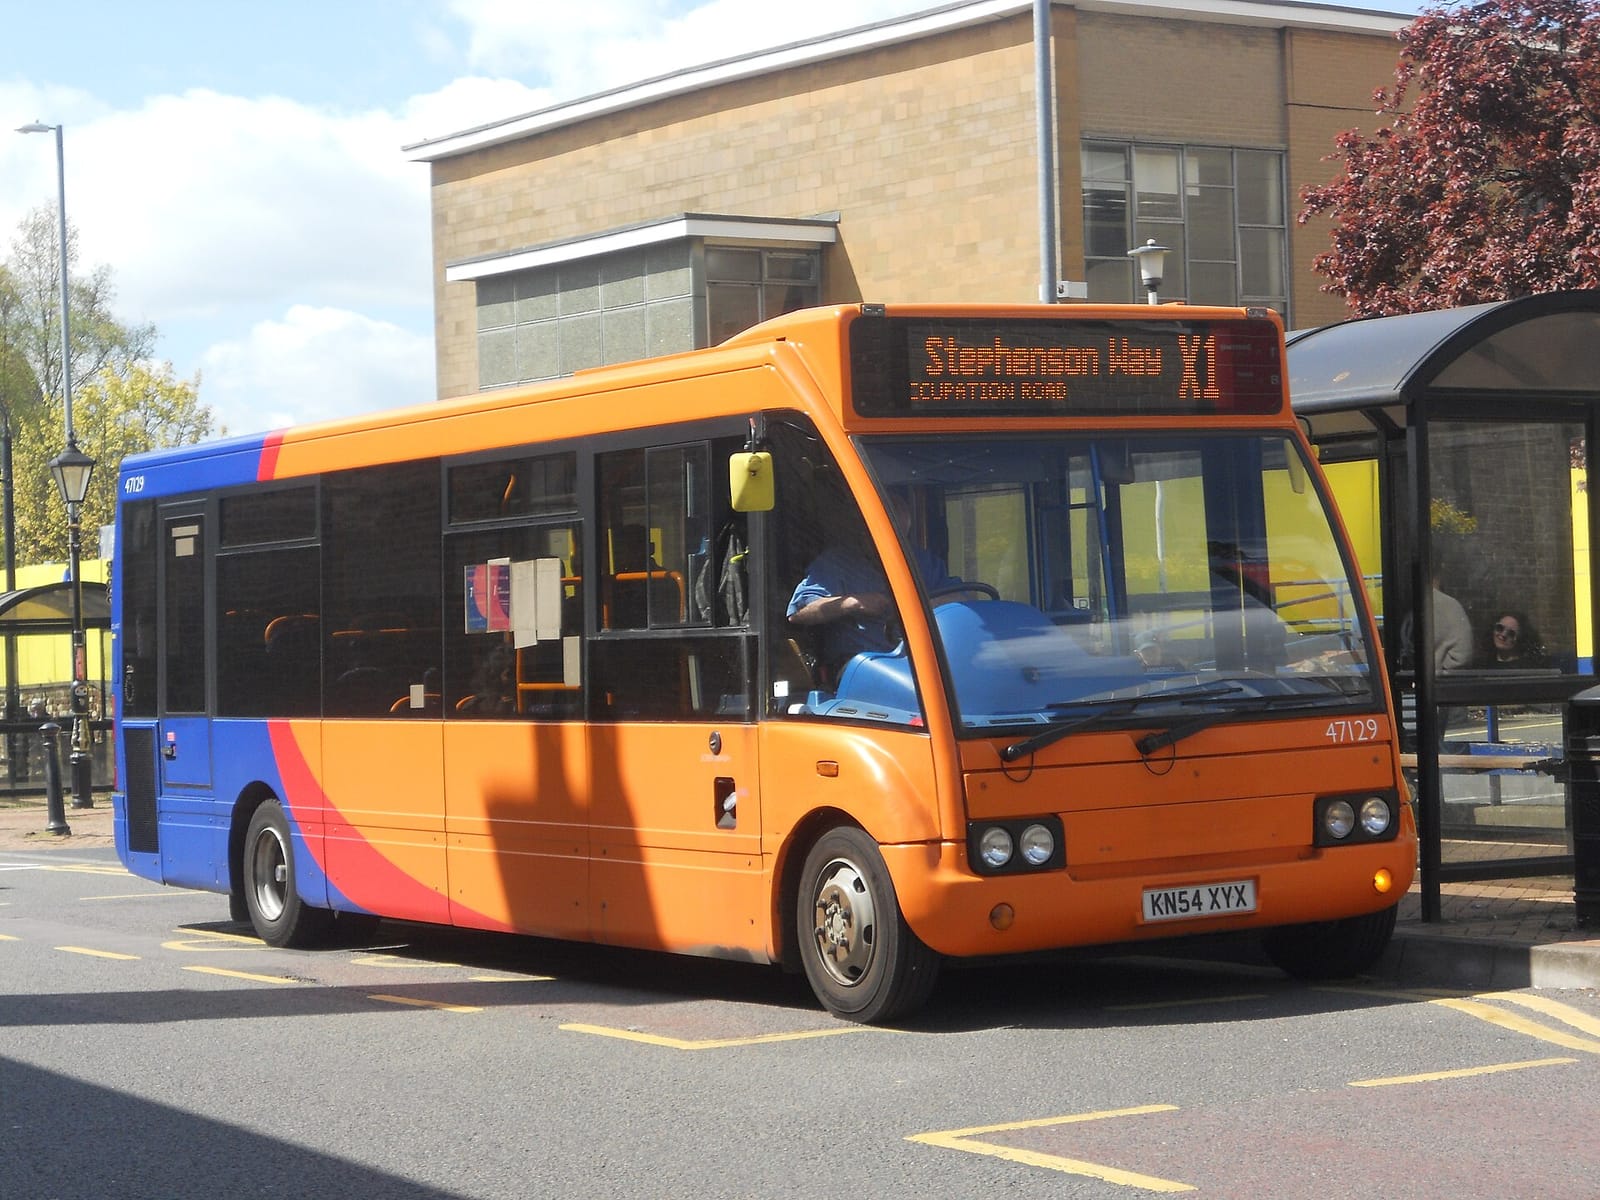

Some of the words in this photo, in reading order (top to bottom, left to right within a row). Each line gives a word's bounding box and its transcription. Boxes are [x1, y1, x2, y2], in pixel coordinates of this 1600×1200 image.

[925, 336, 1099, 376] Stephenson
[1109, 337, 1162, 376] Way
[1178, 335, 1219, 399] X1
[1021, 381, 1068, 399] ROAD
[125, 475, 145, 493] 47129
[1325, 719, 1377, 743] 47129
[1150, 889, 1203, 916] KN54
[1208, 884, 1247, 910] XYX
